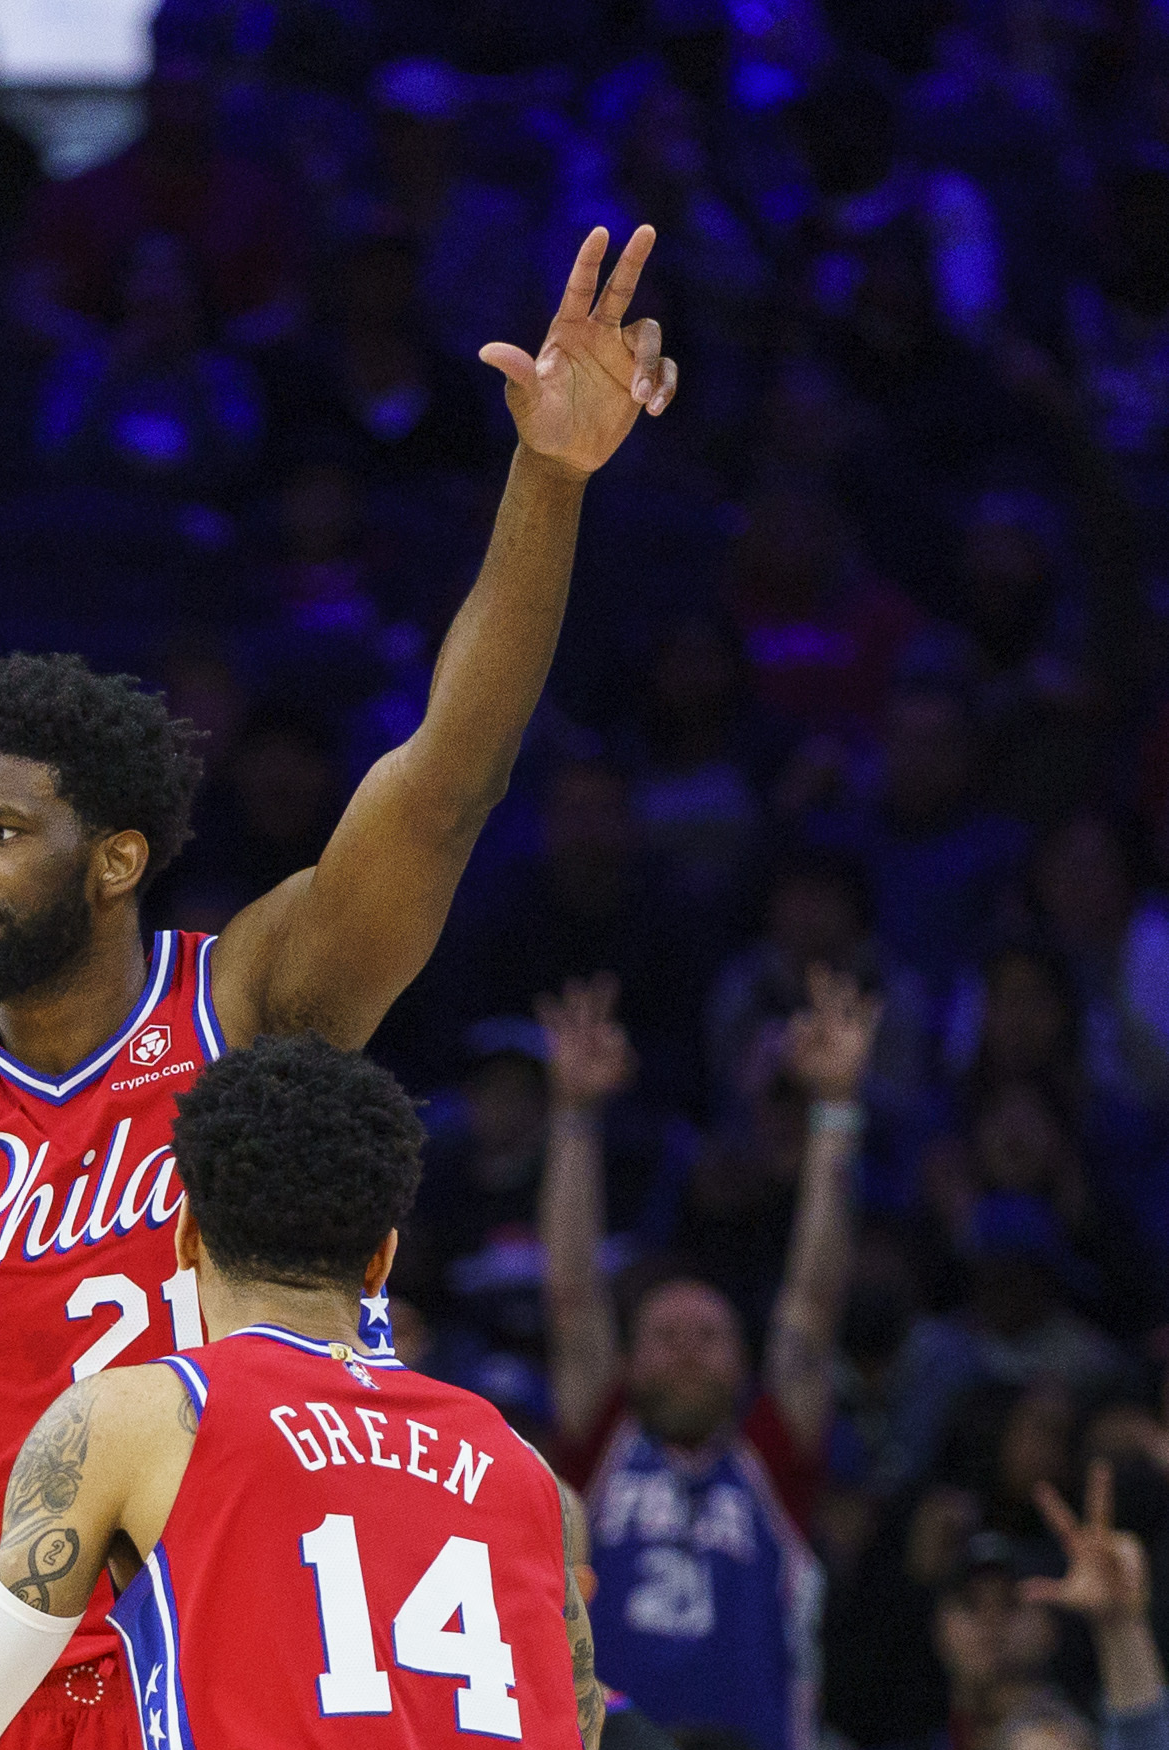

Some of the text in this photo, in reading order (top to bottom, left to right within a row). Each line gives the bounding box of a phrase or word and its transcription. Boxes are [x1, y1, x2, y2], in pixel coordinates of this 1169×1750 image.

[111, 1060, 195, 1091] crypto.com
[65, 1267, 205, 1384] 21
[270, 1402, 494, 1505] GREEN
[298, 1513, 523, 1742] 14
